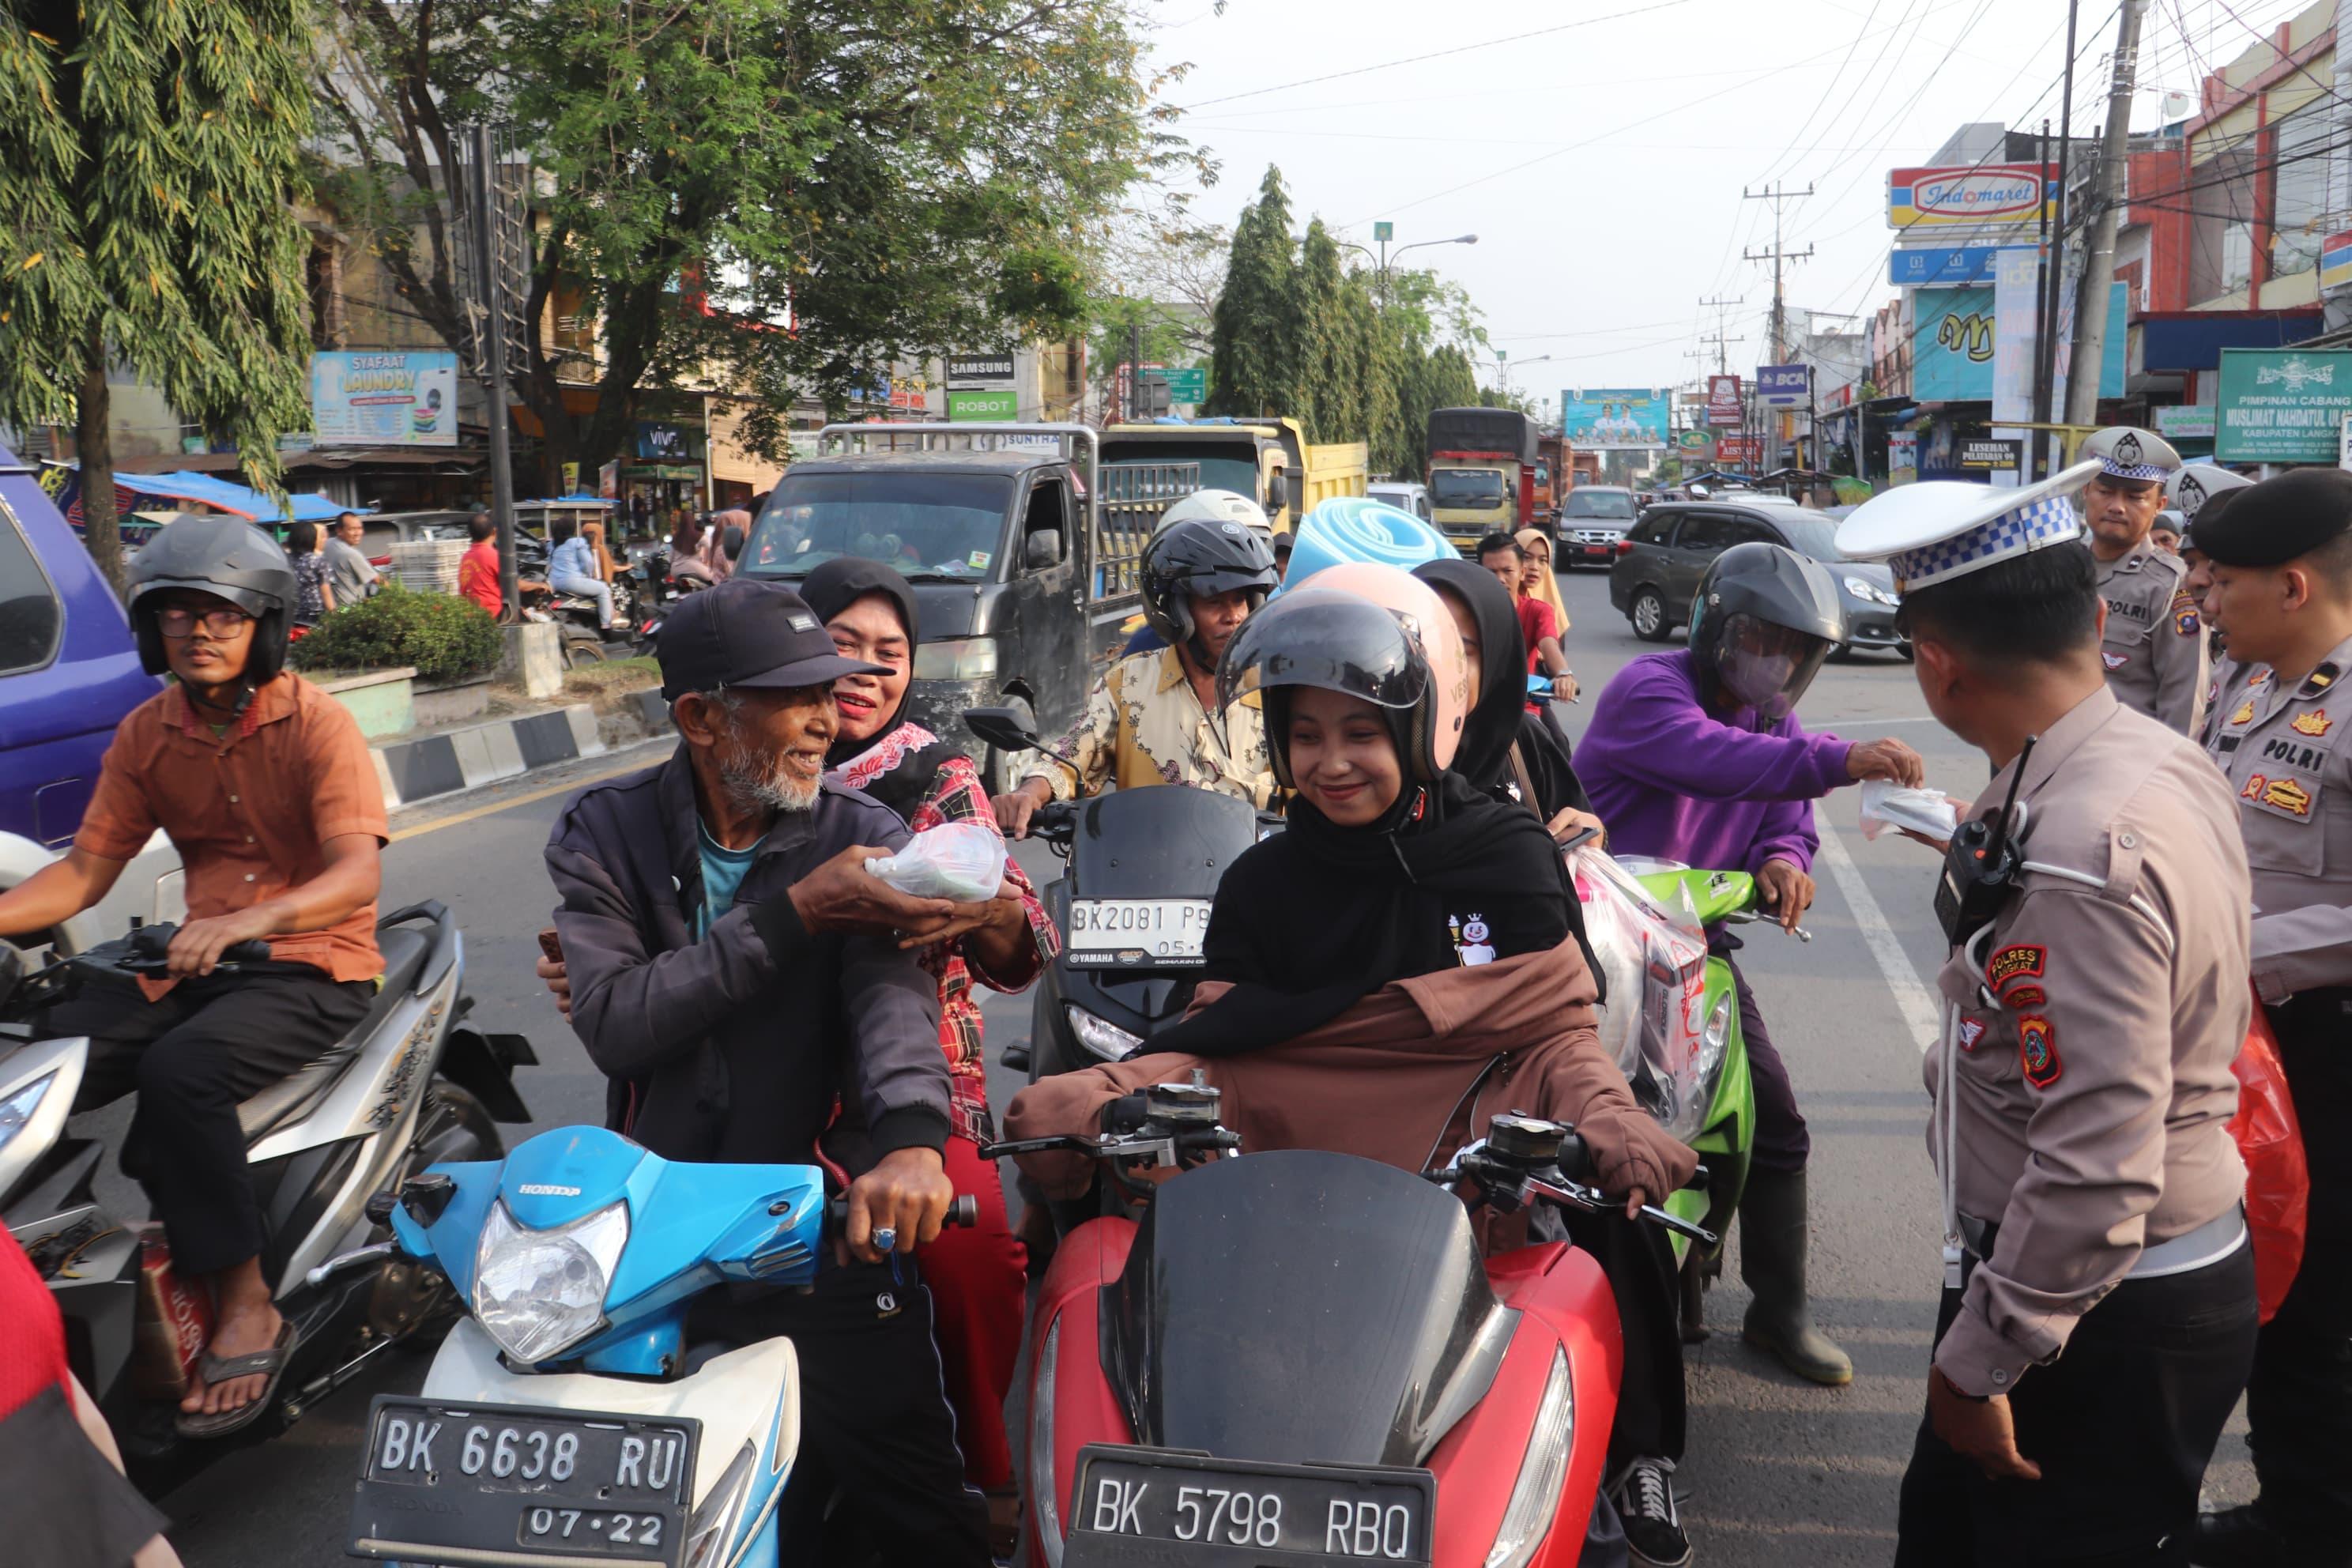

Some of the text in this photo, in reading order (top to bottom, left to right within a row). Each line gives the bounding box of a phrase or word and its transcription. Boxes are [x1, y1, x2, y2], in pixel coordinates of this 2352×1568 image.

[1924, 183, 2032, 205] Indomaret
[352, 356, 405, 370] SYAFAAT
[951, 362, 1012, 374] SAMSUNG
[344, 370, 416, 393] LAUNDRY
[1776, 373, 1805, 386] BCA
[956, 401, 1009, 412] ROBOT
[2239, 396, 2351, 405] PIMPINAN CABANG
[2226, 409, 2275, 427] MUSLIMAT
[2276, 409, 2326, 427] NAHDATUL
[2302, 429, 2340, 438] LANGKA
[1969, 443, 2010, 452] LESEHAN
[2263, 738, 2324, 772] POLRI
[1080, 953, 1114, 963] YAMAHA
[1994, 962, 2032, 981] ANGKAT
[380, 1419, 677, 1491] BK 6638 RU
[1093, 1479, 1410, 1559] BK 5798 RBQ
